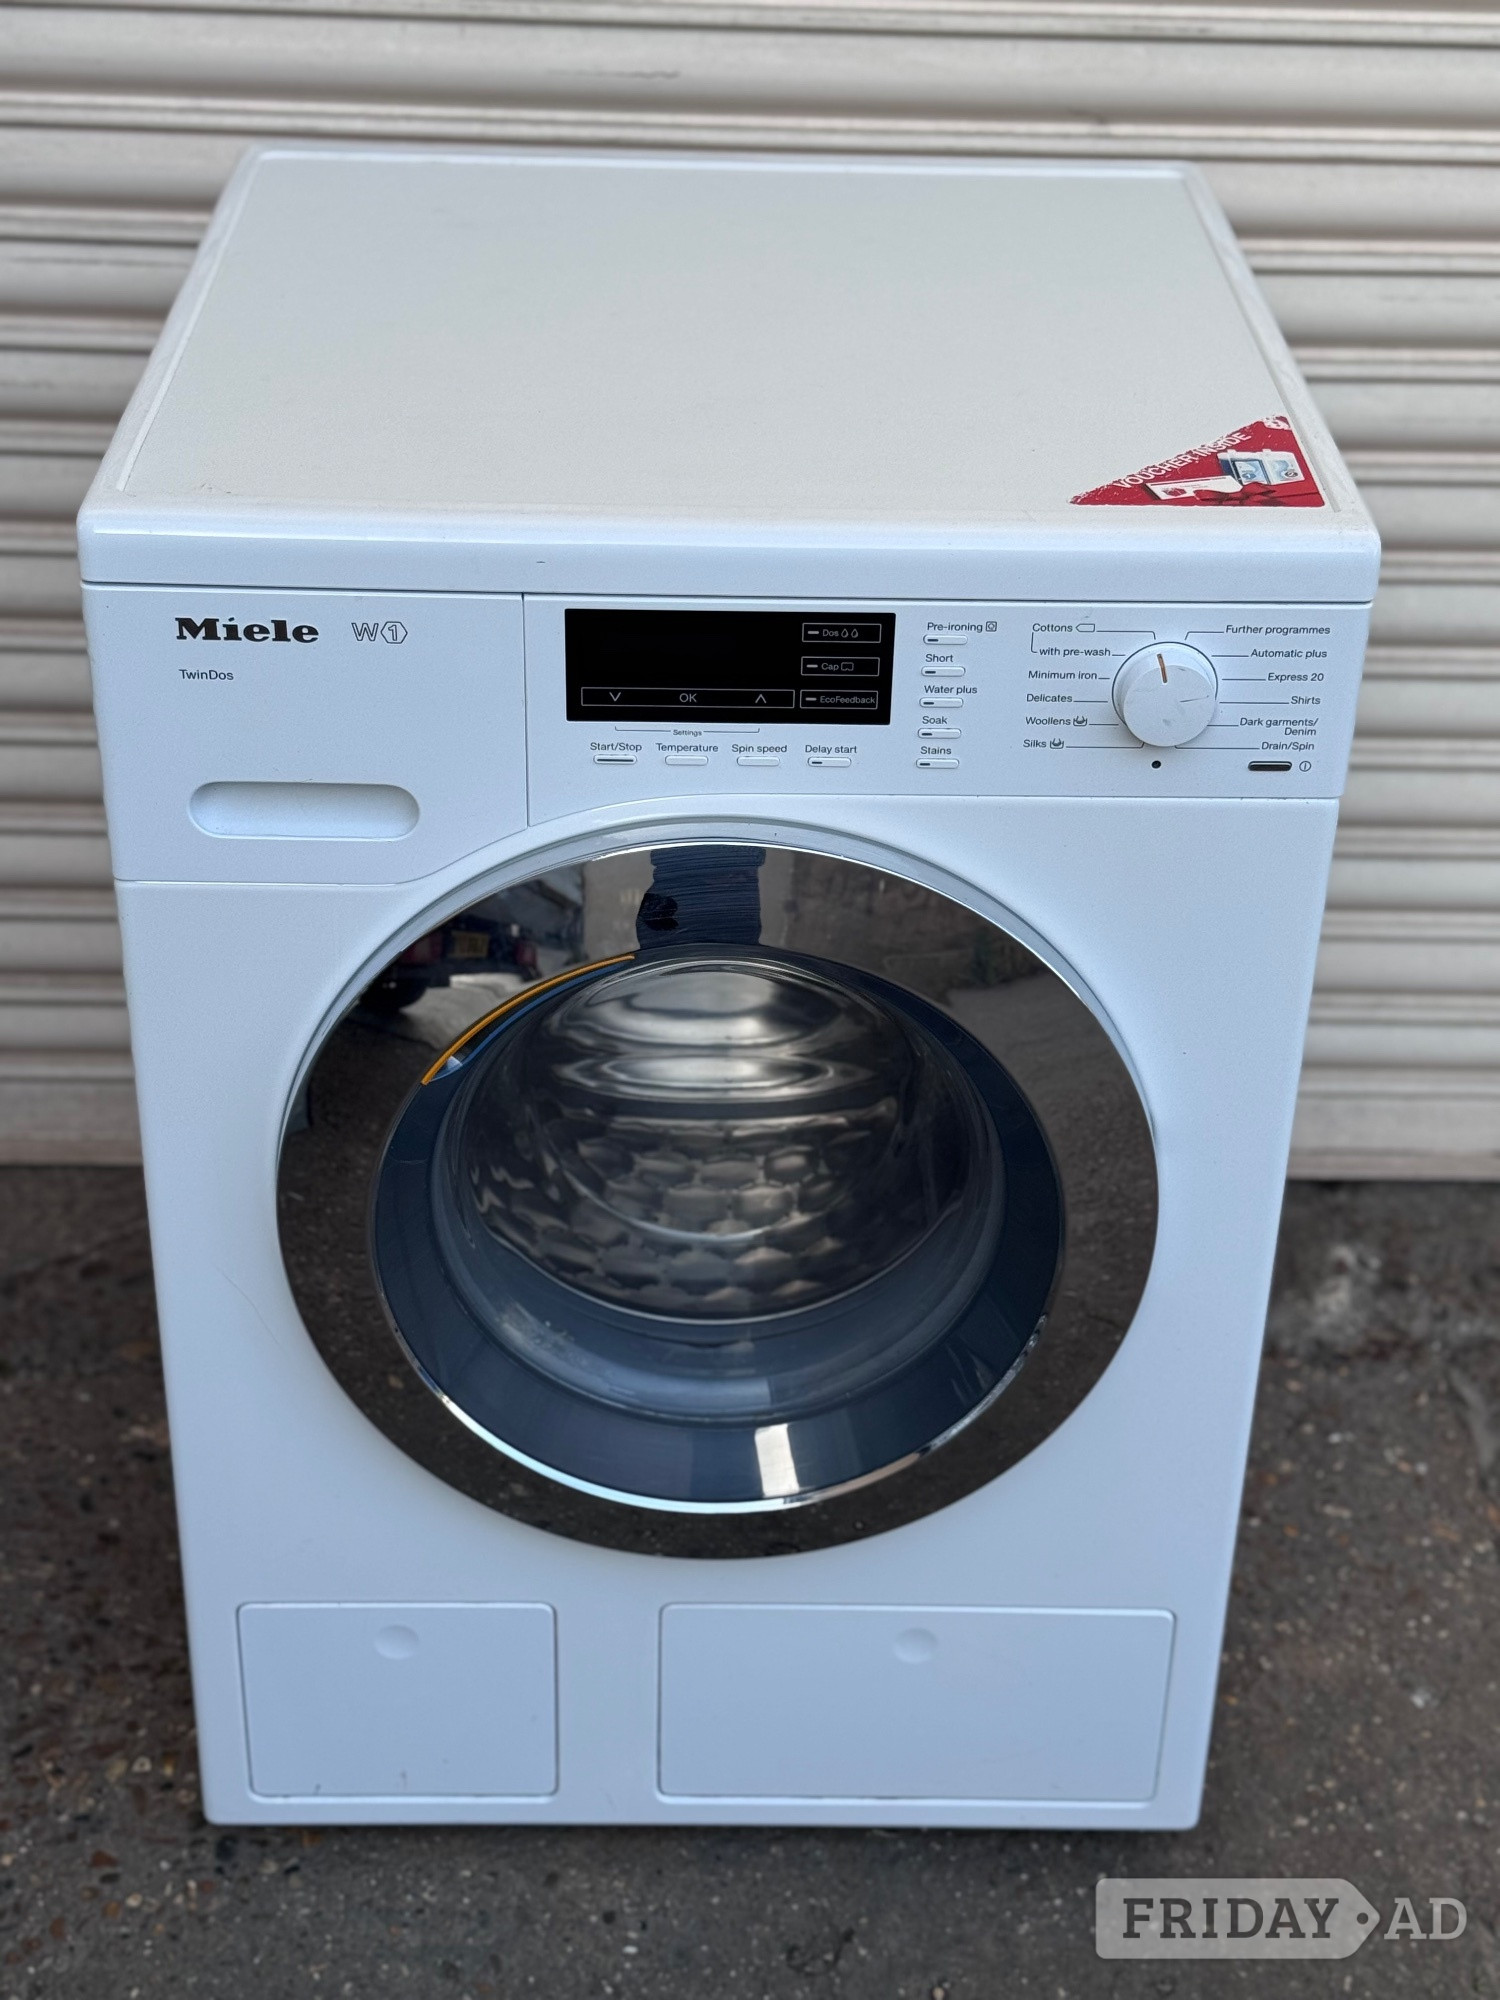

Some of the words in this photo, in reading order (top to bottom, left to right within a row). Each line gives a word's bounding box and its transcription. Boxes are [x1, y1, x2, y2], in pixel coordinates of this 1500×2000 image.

[174, 617, 319, 643] Miele
[822, 628, 839, 637] Dos
[927, 622, 983, 633] Pre-ironing
[1032, 623, 1073, 633] Cottons
[1225, 625, 1263, 634] Further
[1266, 626, 1331, 636] programmes
[925, 653, 954, 663] Short
[1039, 648, 1060, 657] with
[1063, 648, 1111, 658] pre-wash
[1250, 649, 1303, 658] Automatic
[1305, 649, 1328, 660] plus
[821, 662, 839, 673] Cap
[178, 669, 234, 681] TwinDos
[1028, 671, 1075, 680] Minimum
[1077, 671, 1098, 680] iron
[1267, 673, 1309, 683] Express
[1311, 673, 1324, 682] 20
[924, 685, 954, 694] Water
[956, 685, 978, 696] plus
[679, 692, 697, 703] OK
[819, 694, 876, 705] EcoFeedback
[1026, 694, 1073, 703] Delicates
[1290, 696, 1321, 705] Shirts
[922, 716, 948, 725] Soak
[1025, 716, 1071, 726] Woollens
[1240, 717, 1263, 727] Dark
[1265, 718, 1319, 728] garments/
[672, 728, 702, 738] Settings
[1284, 727, 1317, 736] Denim
[590, 742, 642, 753] Start/Stop
[656, 743, 719, 755] Temperature
[731, 743, 754, 755] Spin
[757, 743, 788, 755] speed
[805, 744, 832, 755] Delay
[835, 744, 858, 754] start
[1023, 739, 1047, 749] Silks
[1261, 741, 1315, 752] Drain/Spin
[920, 746, 952, 756] Stains
